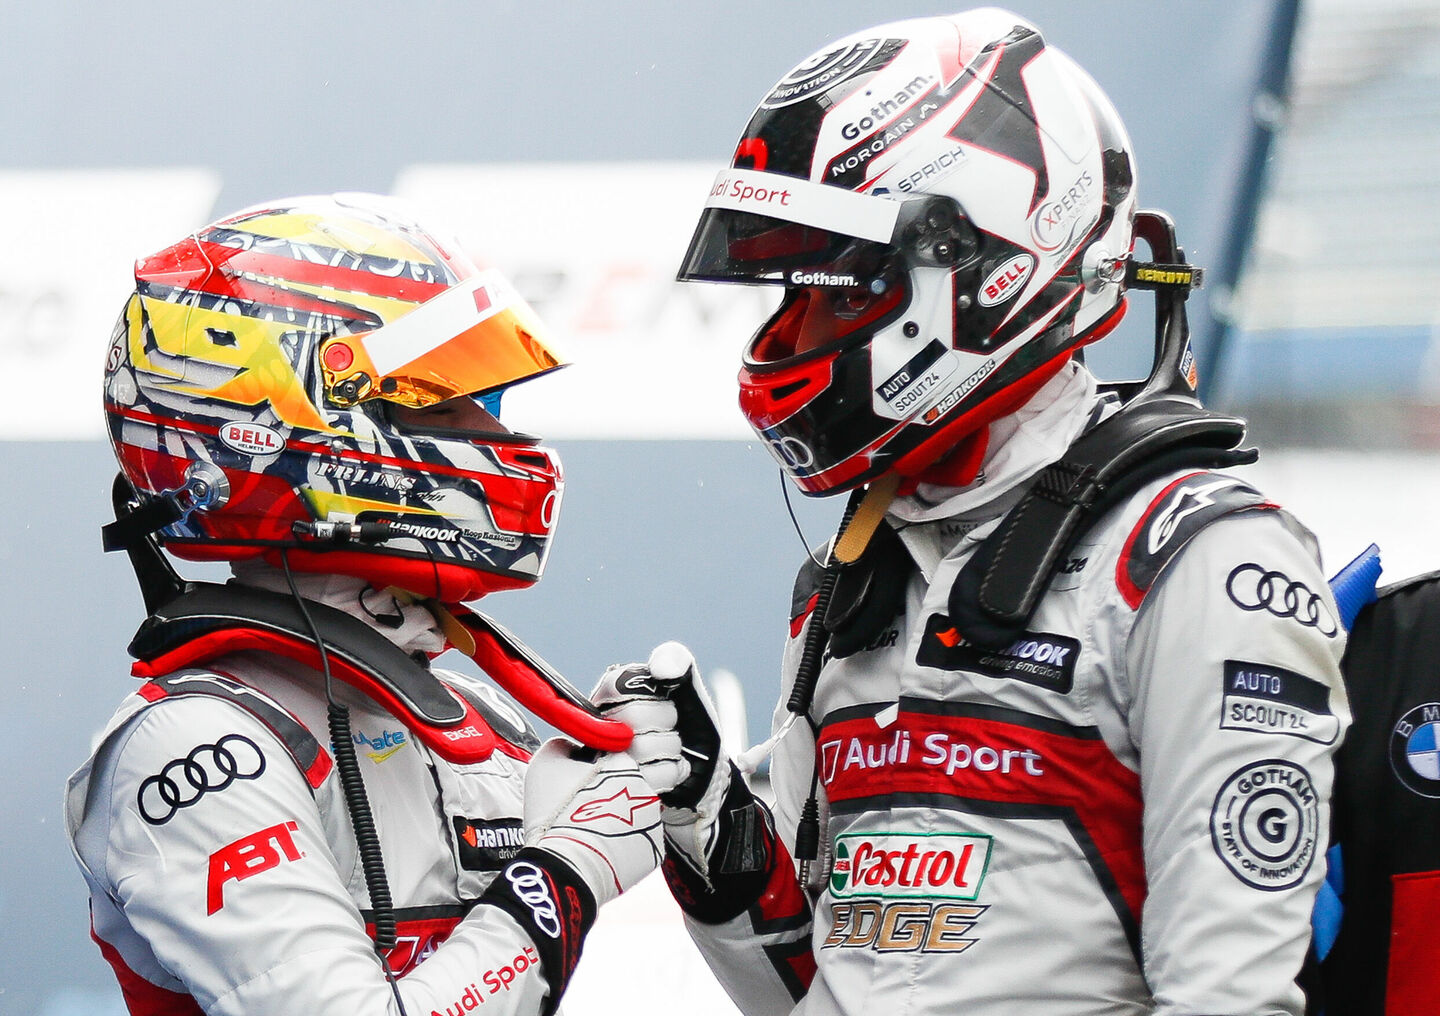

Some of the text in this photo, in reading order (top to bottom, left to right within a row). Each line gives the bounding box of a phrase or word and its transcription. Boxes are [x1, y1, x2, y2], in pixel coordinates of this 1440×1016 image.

[831, 117, 915, 177] NORQAIN
[898, 146, 966, 193] SPRICH
[708, 178, 791, 206] udi Sport
[983, 261, 1030, 301] BELL
[882, 370, 911, 399] AUTO
[895, 372, 940, 412] SCOUT 24
[228, 427, 277, 448] BELL
[1015, 660, 1062, 679] emotion
[1233, 670, 1281, 695] AUTO
[1230, 703, 1288, 727] SCOUT
[1396, 706, 1440, 739] BM
[842, 730, 1045, 777] Audi Sport
[1237, 768, 1314, 807] GOTHAM
[1256, 807, 1288, 844] G
[851, 841, 974, 888] Castrol
[1221, 821, 1241, 861] STATE
[1241, 855, 1261, 873] OF
[206, 820, 302, 918] ABT
[821, 901, 992, 954] EDGE
